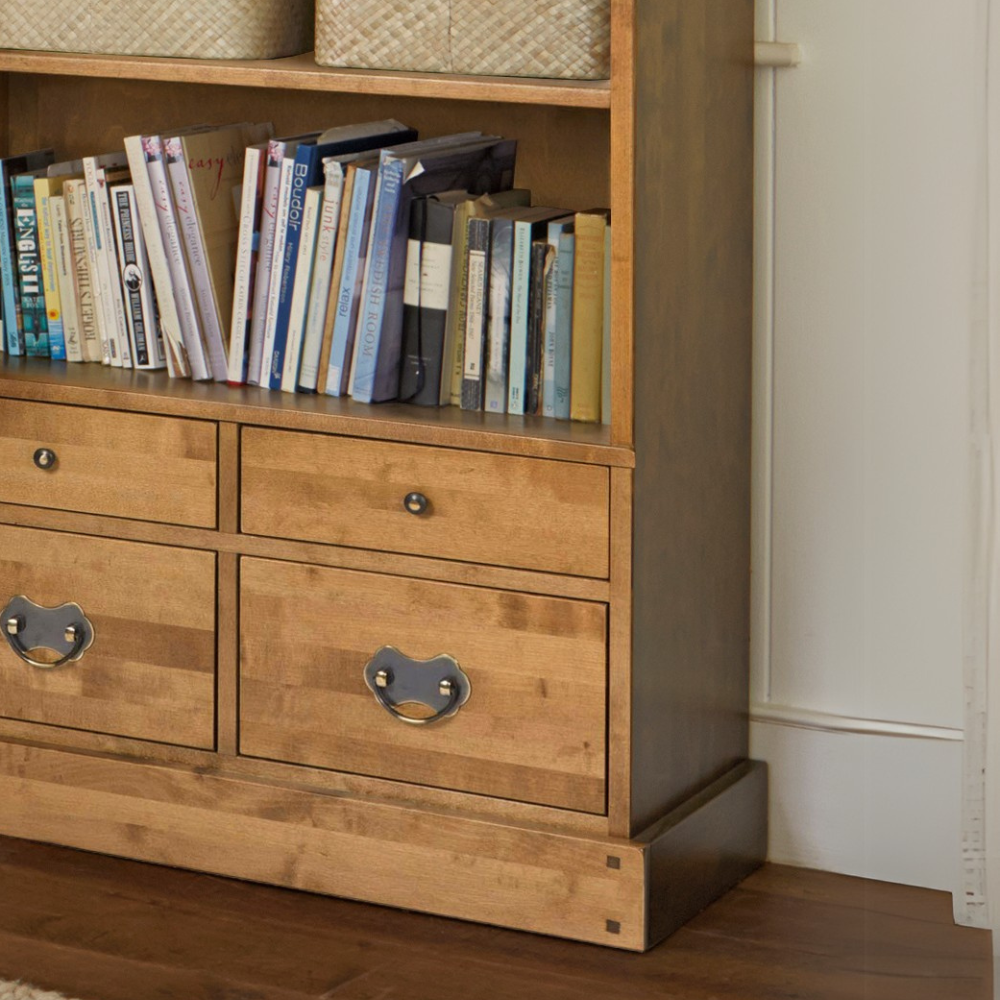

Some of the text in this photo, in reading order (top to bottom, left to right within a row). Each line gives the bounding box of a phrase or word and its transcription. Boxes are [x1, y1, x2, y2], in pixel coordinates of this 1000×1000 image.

[86, 161, 94, 187] YOGA
[188, 158, 224, 201] easy
[288, 163, 308, 231] Boudoir
[119, 193, 136, 262] THE PRINCESS BRIDE
[165, 214, 182, 265] elegance
[184, 216, 202, 266] elegance
[241, 215, 252, 246] CROSS
[319, 199, 338, 262] junk style
[71, 218, 90, 289] THESAURUS
[239, 249, 250, 282] STITCH
[237, 286, 245, 310] KATRIN
[280, 265, 291, 304] Robertson
[338, 286, 351, 317] relax
[362, 239, 388, 357] SWEDISH ROOM
[131, 293, 145, 351] WILLIAM GOLDMAN
